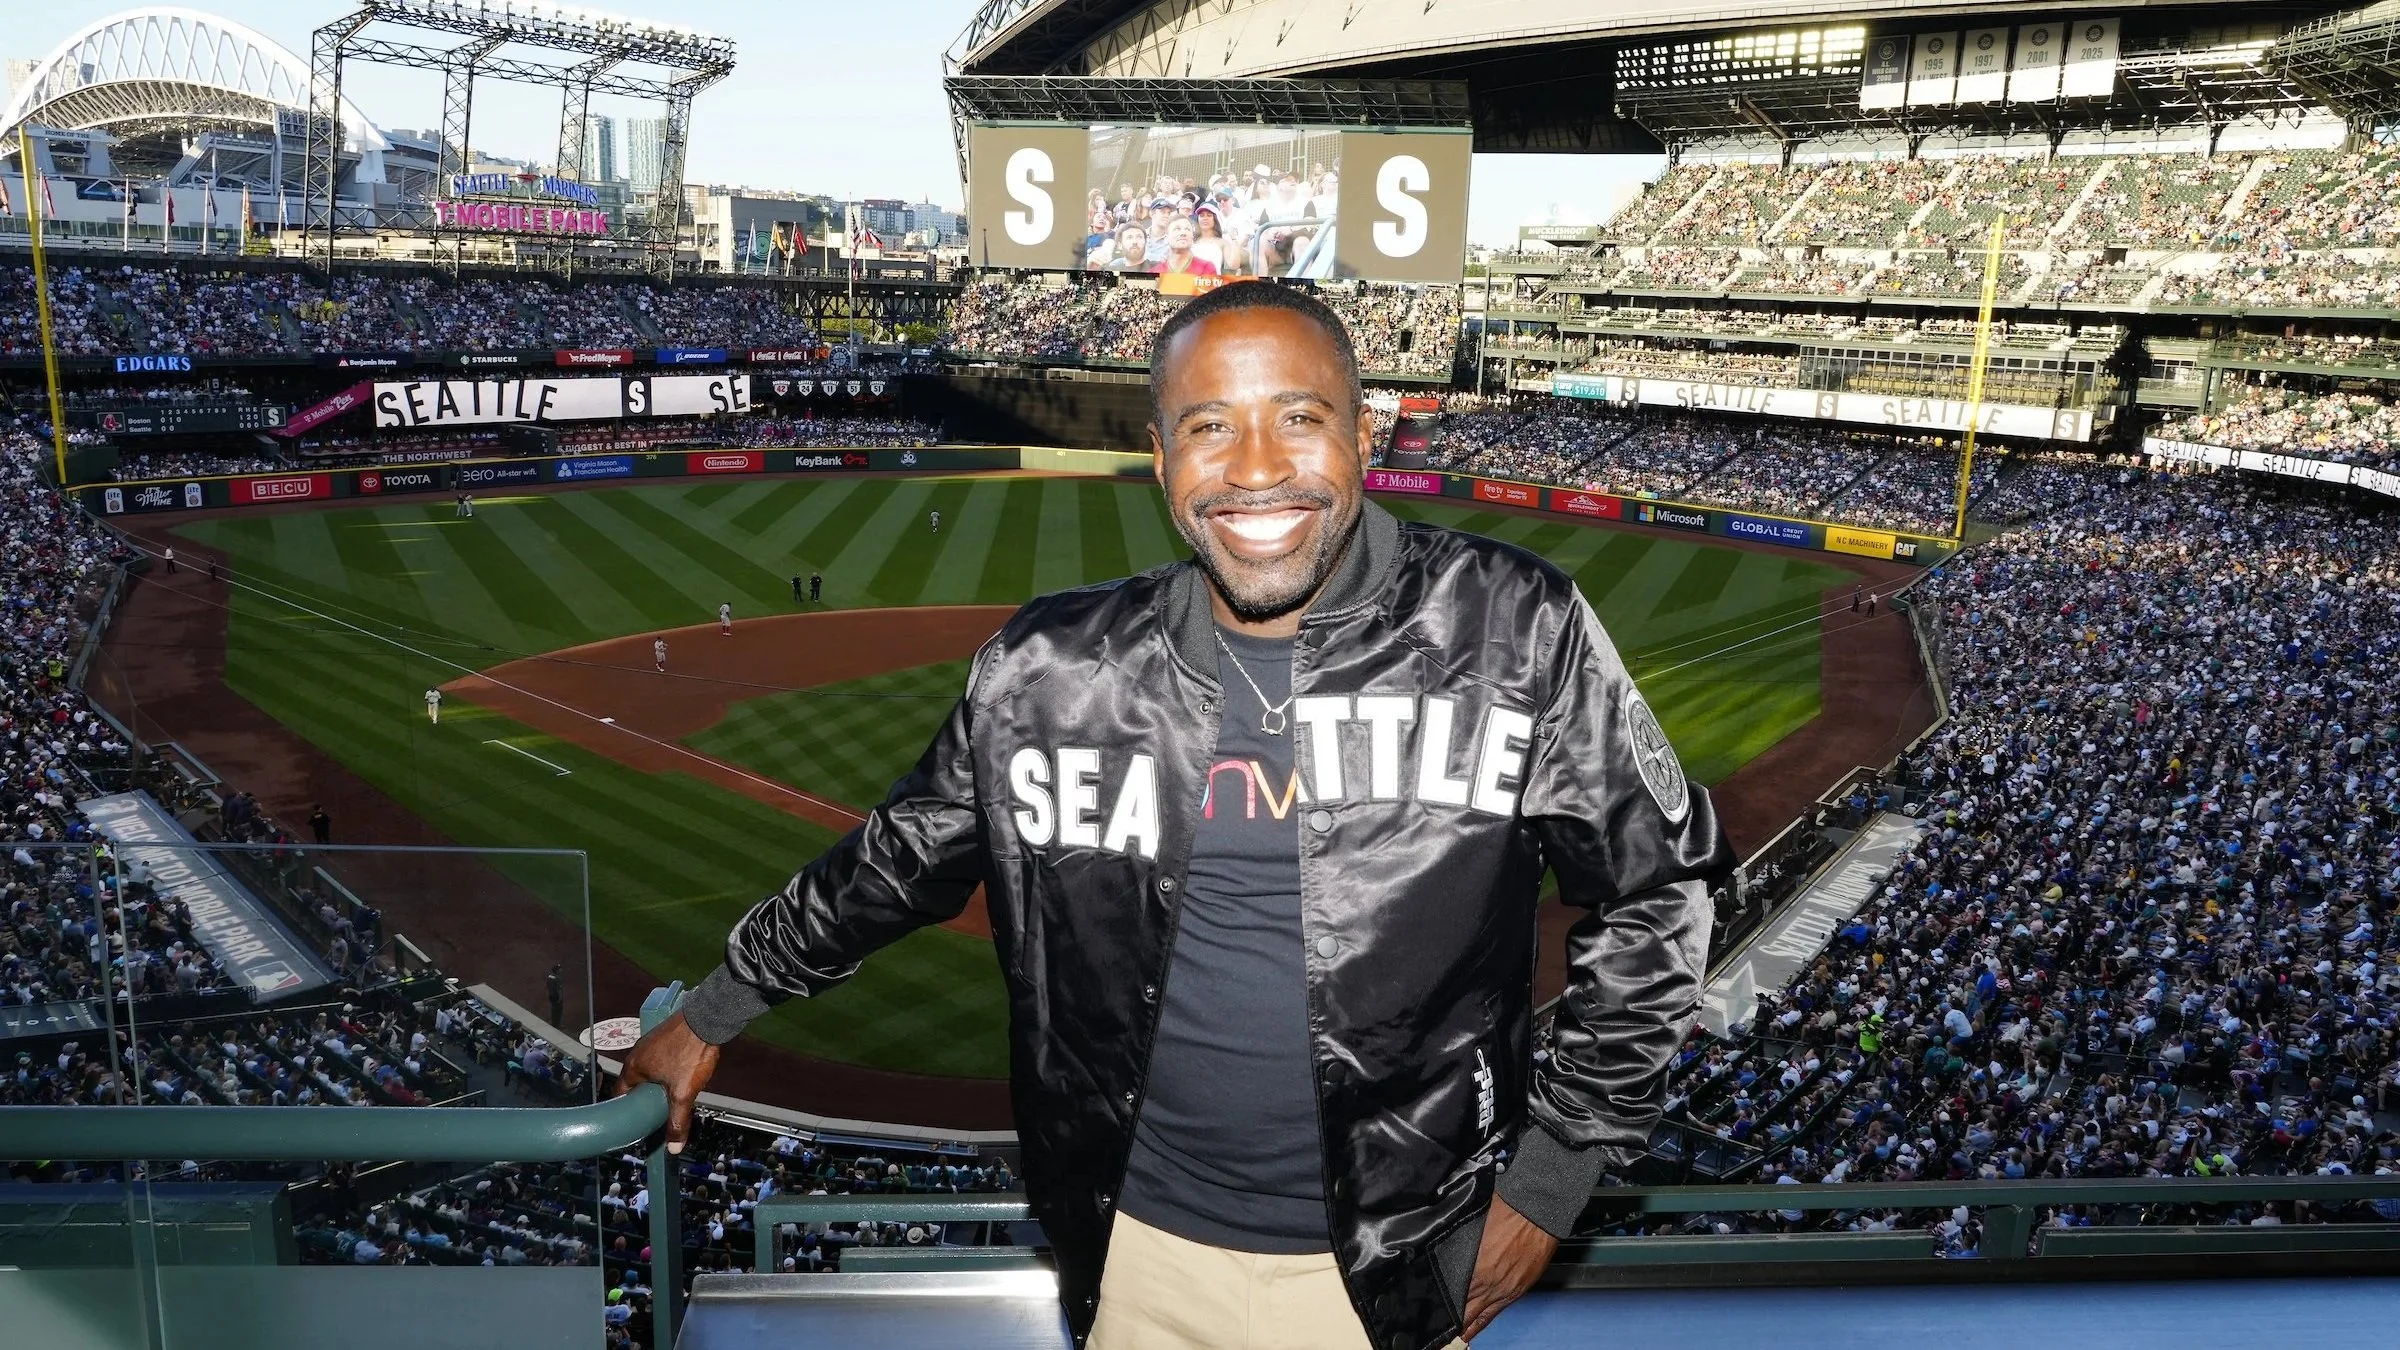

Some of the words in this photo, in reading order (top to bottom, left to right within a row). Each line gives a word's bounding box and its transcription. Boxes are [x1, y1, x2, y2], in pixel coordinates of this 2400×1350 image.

[2027, 51, 2048, 64] 2001
[2081, 48, 2103, 60] 2025
[1924, 58, 1943, 70] 1995
[1974, 55, 1993, 67] 1997
[452, 173, 511, 196] SEATTLE
[543, 173, 598, 206] MARINERS
[1004, 147, 1055, 246] S
[1373, 155, 1430, 258] S
[550, 210, 609, 234] PARK
[1528, 227, 1587, 235] MUCKLESHOOT
[349, 359, 377, 367] Benjamin
[472, 355, 518, 364] STARBUCKS
[1574, 385, 1605, 397] $19,610
[1625, 380, 1636, 400] S
[377, 380, 557, 427] SEATTLE
[628, 381, 646, 413] S
[310, 405, 334, 420] Mobile
[330, 394, 354, 411] Pen
[1820, 395, 1834, 417] S
[269, 408, 281, 425] S
[2059, 413, 2074, 437] S
[606, 442, 612, 450] &
[614, 441, 637, 450] BEST
[638, 440, 647, 448] IN
[382, 454, 404, 463] THE
[407, 450, 472, 462] NORTHWEST
[707, 459, 746, 467] Nintendo
[795, 455, 842, 468] KeyBank
[2231, 450, 2239, 466] S
[573, 461, 596, 469] Virginia
[606, 465, 628, 473] Health
[384, 474, 431, 486] TOYOTA
[496, 469, 521, 478] All-star
[2350, 467, 2360, 485] S
[1388, 474, 1429, 489] Mobile
[186, 486, 199, 495] Lite
[1484, 484, 1495, 494] fire
[1495, 486, 1503, 494] tv
[106, 492, 121, 500] Lite
[135, 489, 173, 507] Miller
[153, 498, 173, 507] TIME
[1656, 509, 1704, 527] Microsoft
[1731, 520, 1780, 537] GLOBAL
[1782, 527, 1804, 536] CREDIT
[1782, 532, 1801, 540] UNION
[1849, 538, 1888, 551] MACHINERY
[1896, 542, 1916, 557] CAT
[1008, 746, 1160, 864] SEA
[1758, 908, 1839, 964] SEATTLE
[213, 922, 275, 966] PARK
